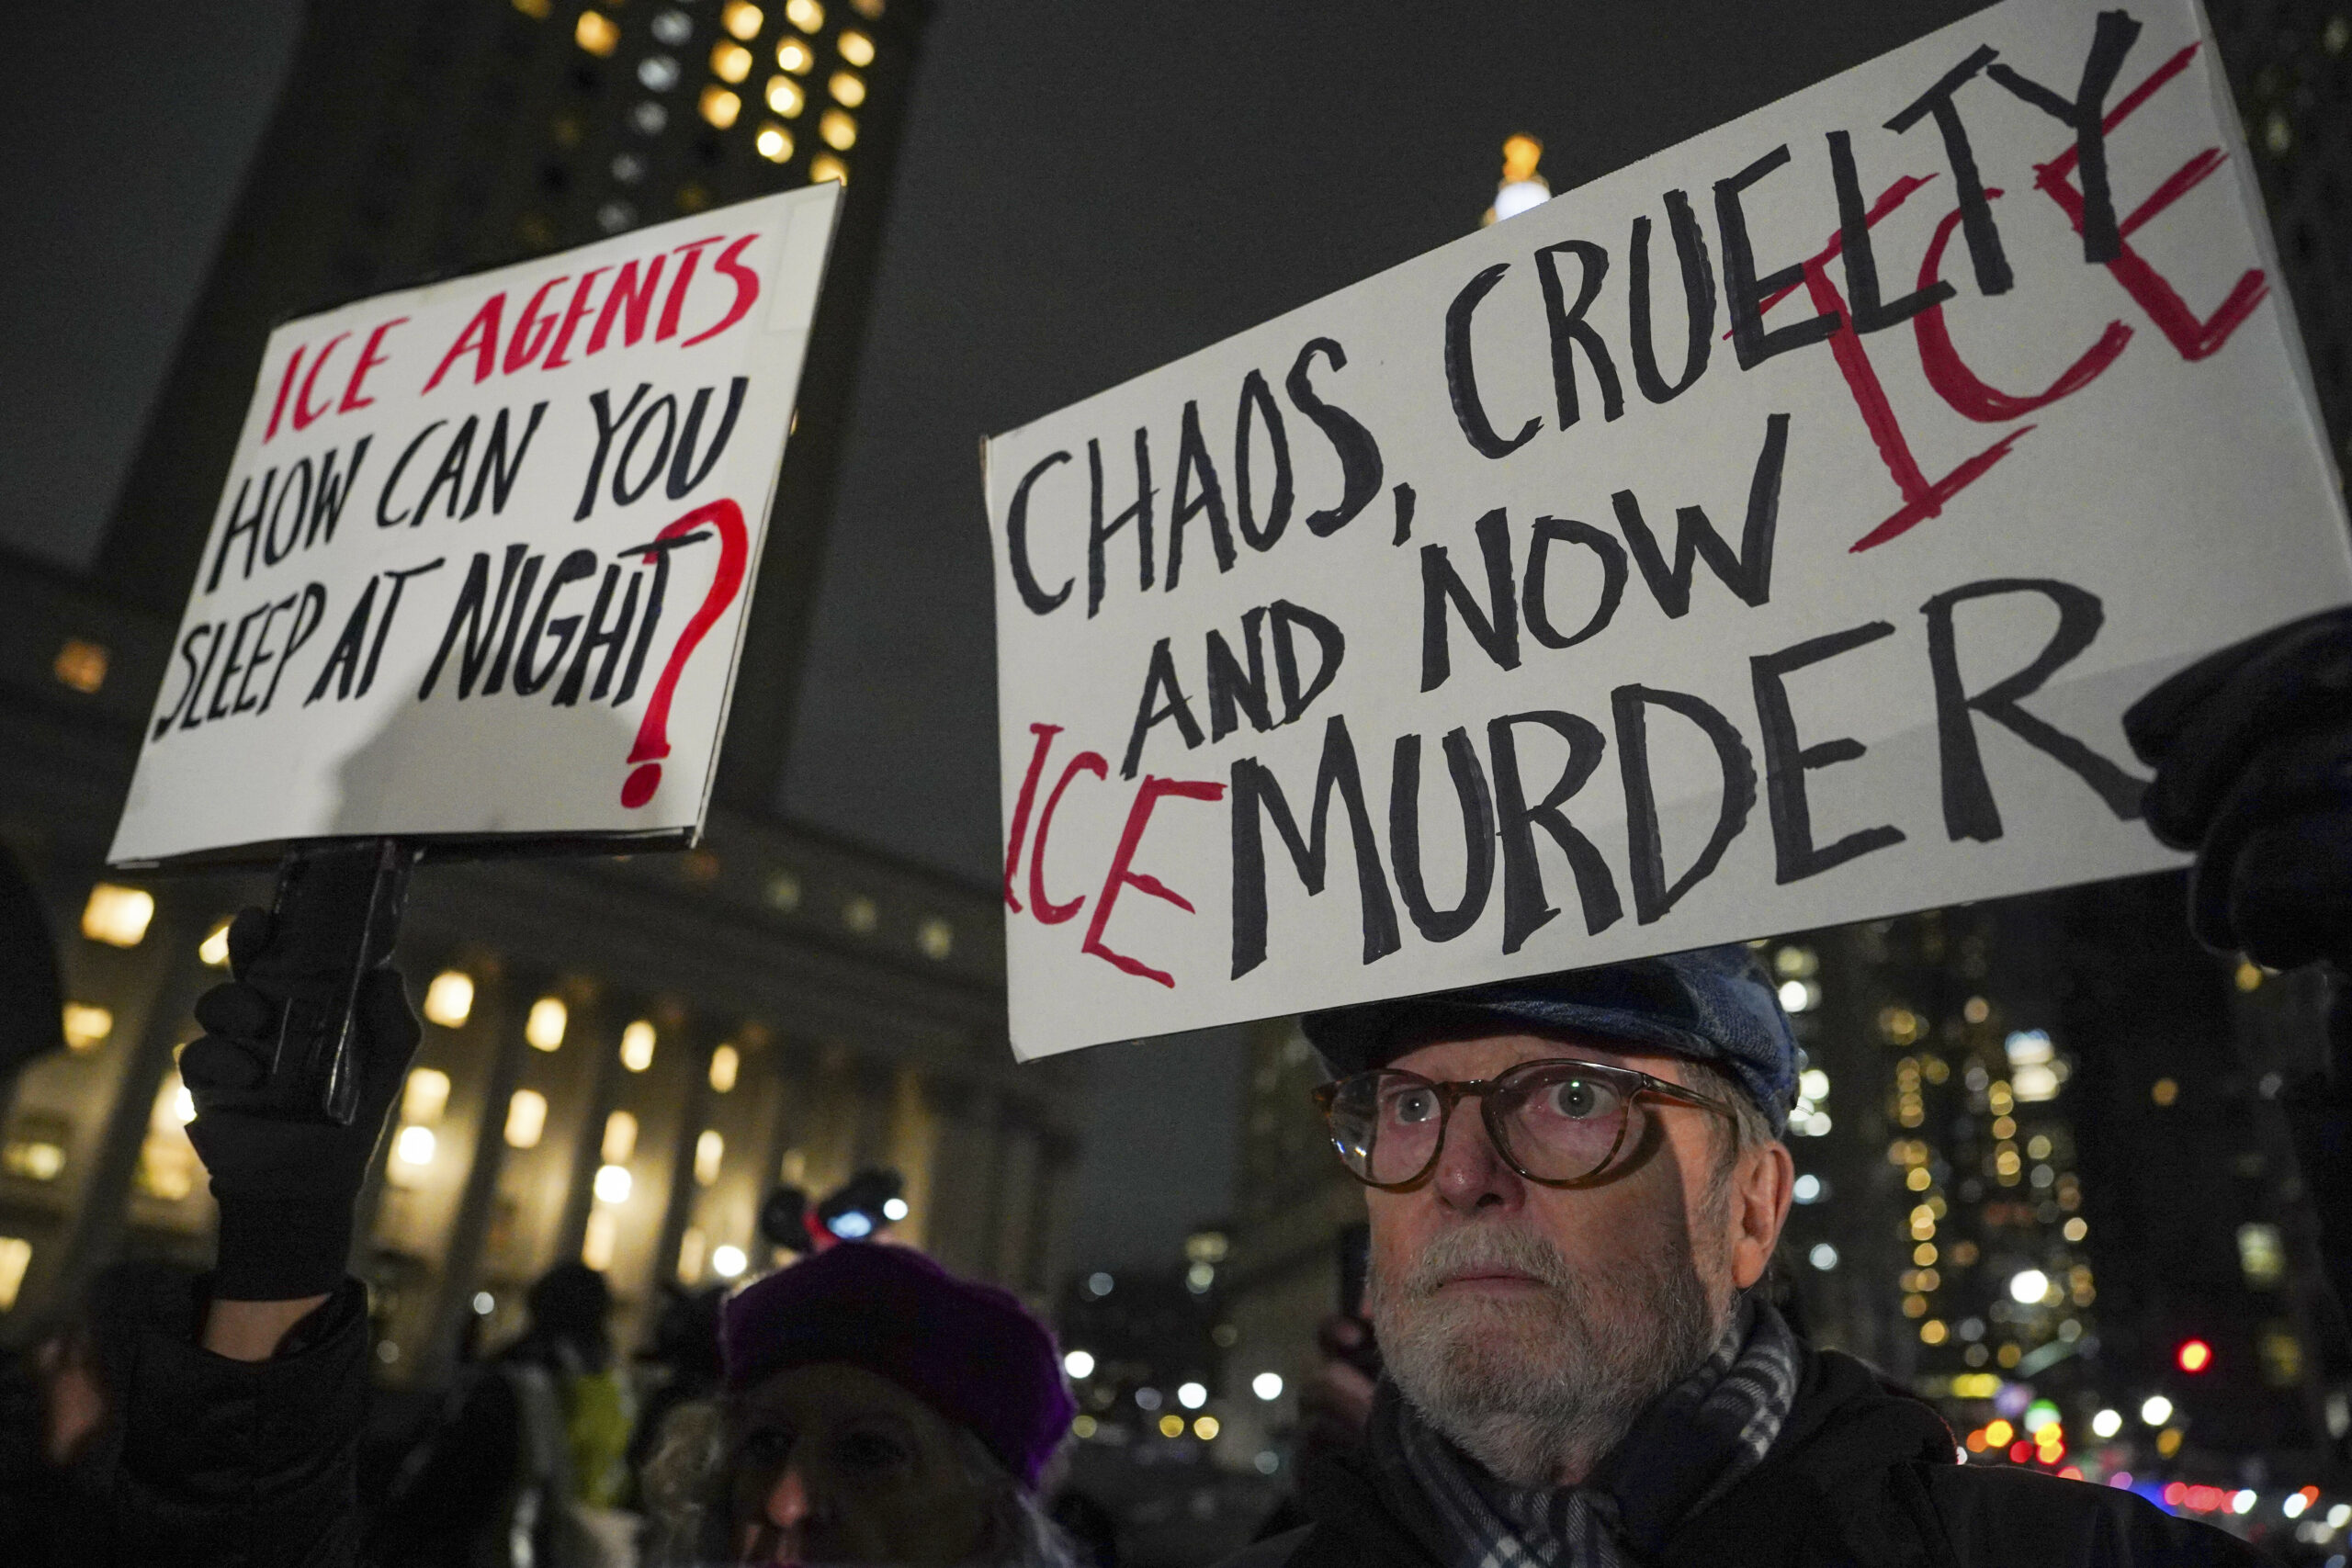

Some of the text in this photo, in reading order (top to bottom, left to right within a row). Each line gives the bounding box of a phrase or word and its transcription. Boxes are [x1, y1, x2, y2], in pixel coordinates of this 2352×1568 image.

[263, 232, 762, 445] ICE AGENTS
[1007, 8, 2143, 619] CHAOS, CRUELTY
[1723, 40, 2271, 554] ICE
[152, 581, 325, 743] SLEEP
[303, 558, 446, 709] AT
[204, 377, 750, 595] HOW CAN YOU
[1119, 413, 1791, 781] AND NOW
[1003, 578, 2156, 989] ICE MURDER
